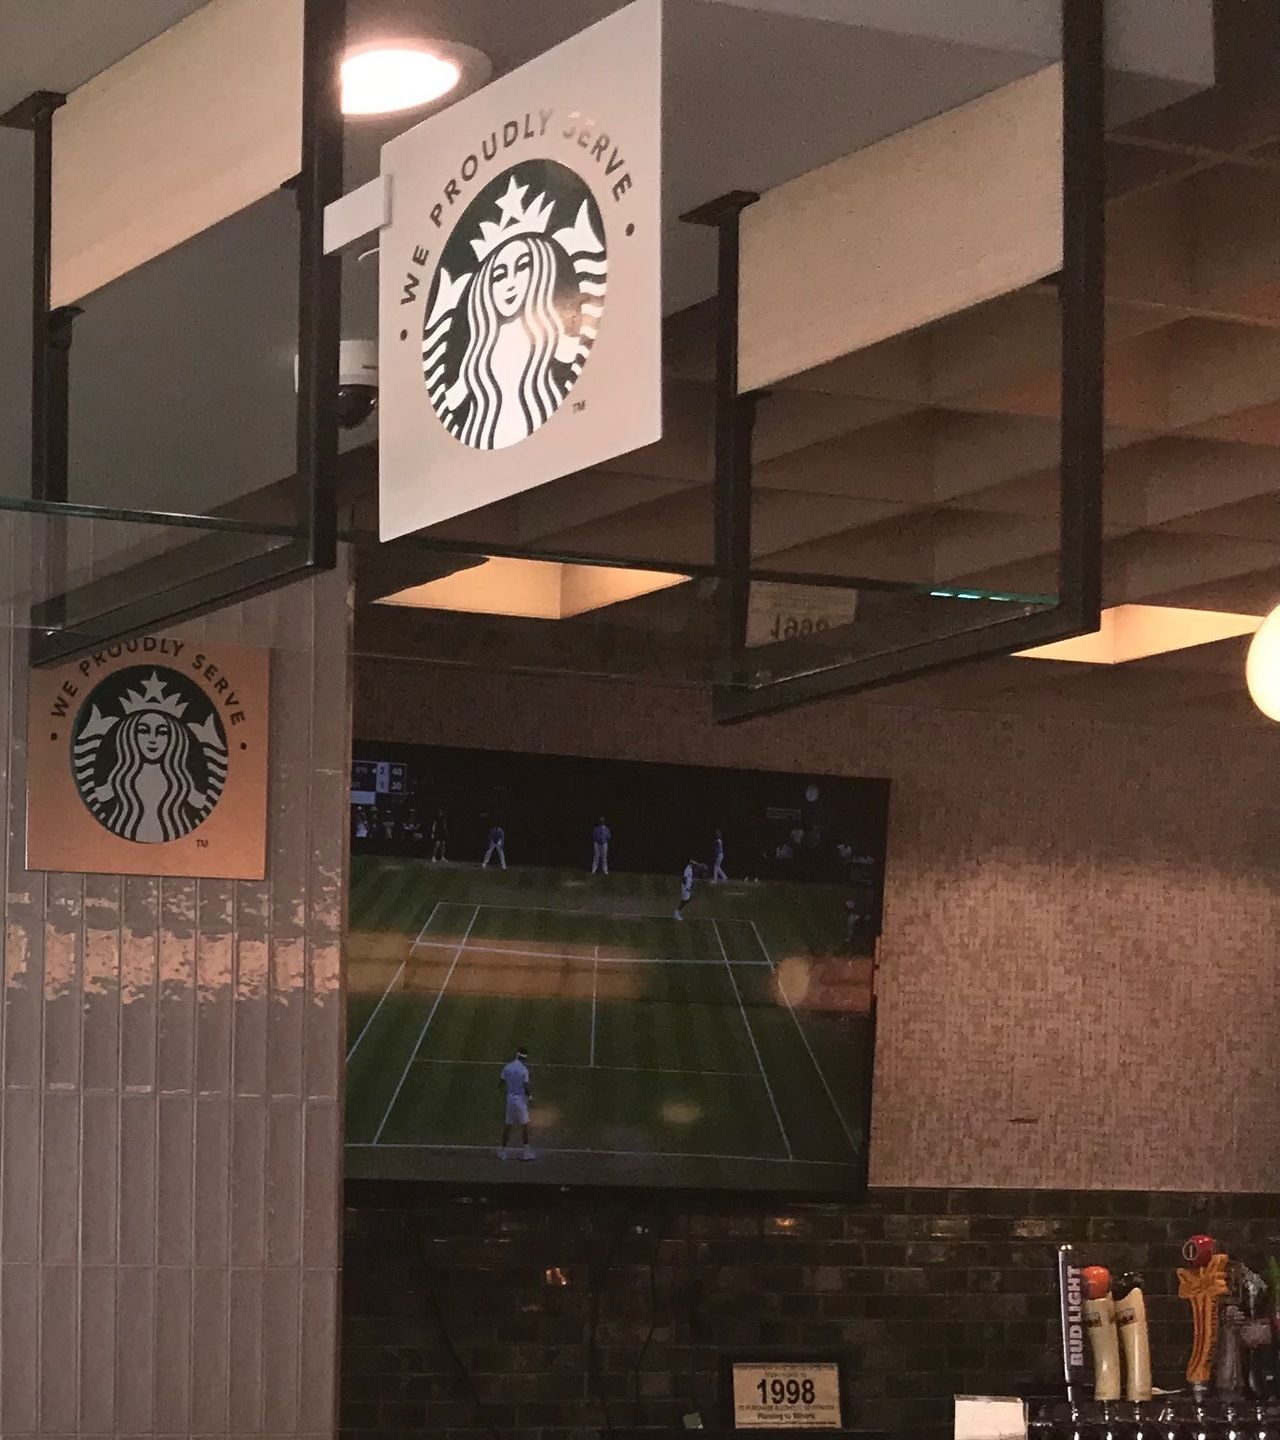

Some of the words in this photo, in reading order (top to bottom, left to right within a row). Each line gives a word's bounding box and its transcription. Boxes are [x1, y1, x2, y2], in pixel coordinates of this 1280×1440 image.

[400, 244, 430, 307] WE
[428, 107, 555, 228] PROUDLY
[561, 111, 634, 204] SERVE
[50, 680, 79, 719] WE
[78, 636, 185, 678] PROUDLY
[191, 653, 246, 726] SERVE
[1066, 1264, 1083, 1323] LIGHT
[1068, 1323, 1085, 1367] BUD
[756, 1378, 816, 1405] 1998
